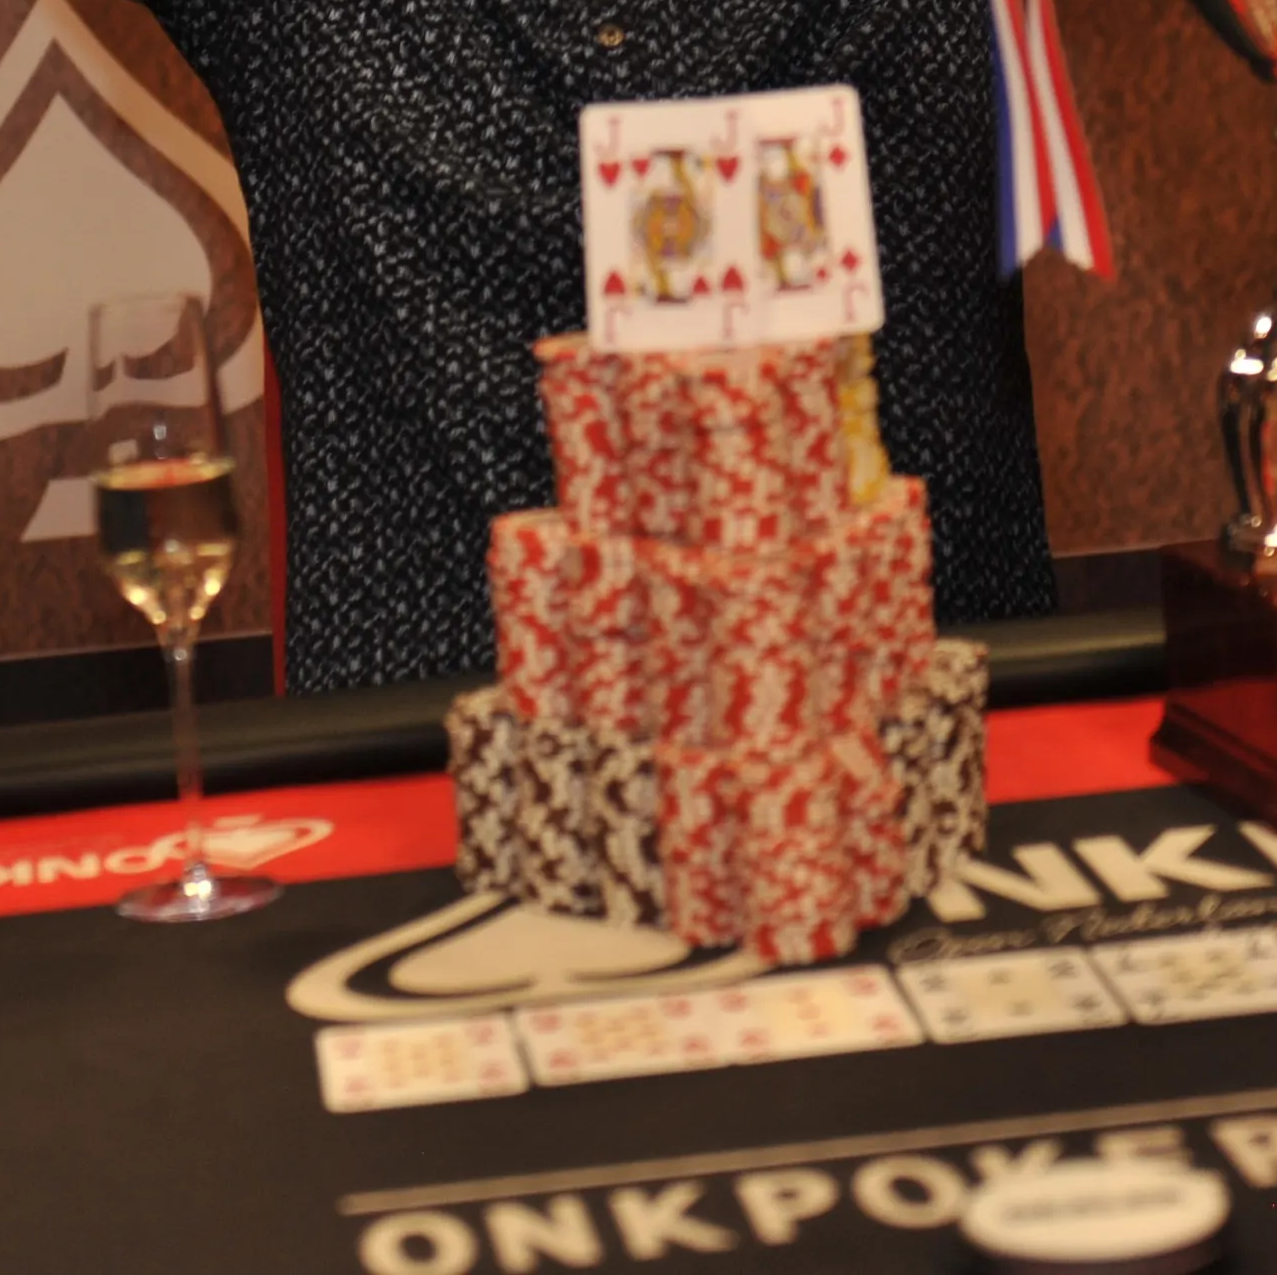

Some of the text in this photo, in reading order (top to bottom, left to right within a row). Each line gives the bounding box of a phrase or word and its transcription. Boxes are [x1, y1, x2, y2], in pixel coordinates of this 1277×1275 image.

[595, 116, 622, 158] J
[710, 109, 740, 153] J
[822, 95, 846, 137] J
